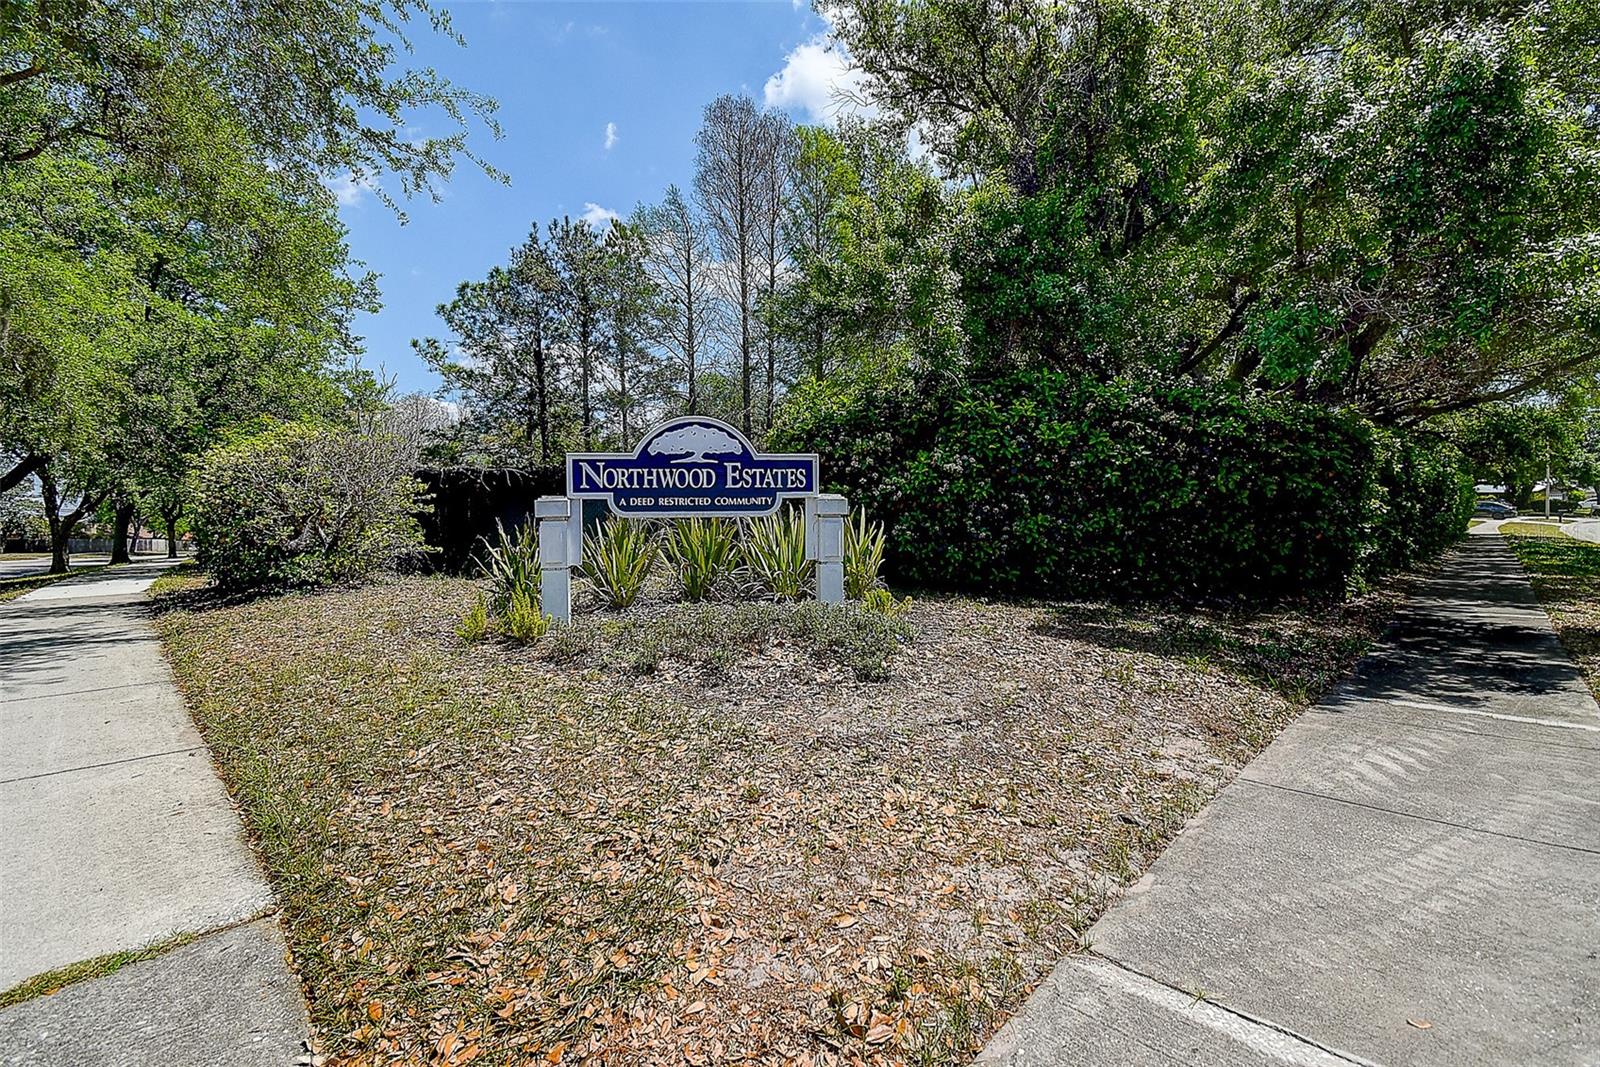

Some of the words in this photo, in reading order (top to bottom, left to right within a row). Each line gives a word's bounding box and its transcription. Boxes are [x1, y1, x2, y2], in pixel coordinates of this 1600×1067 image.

[579, 462, 716, 489] NORTHWOOD
[723, 462, 806, 489] ESTATES
[619, 498, 627, 506] A
[630, 497, 655, 506] DEED
[658, 497, 711, 506] RESTRICTED
[714, 497, 773, 506] COMMUNITY
